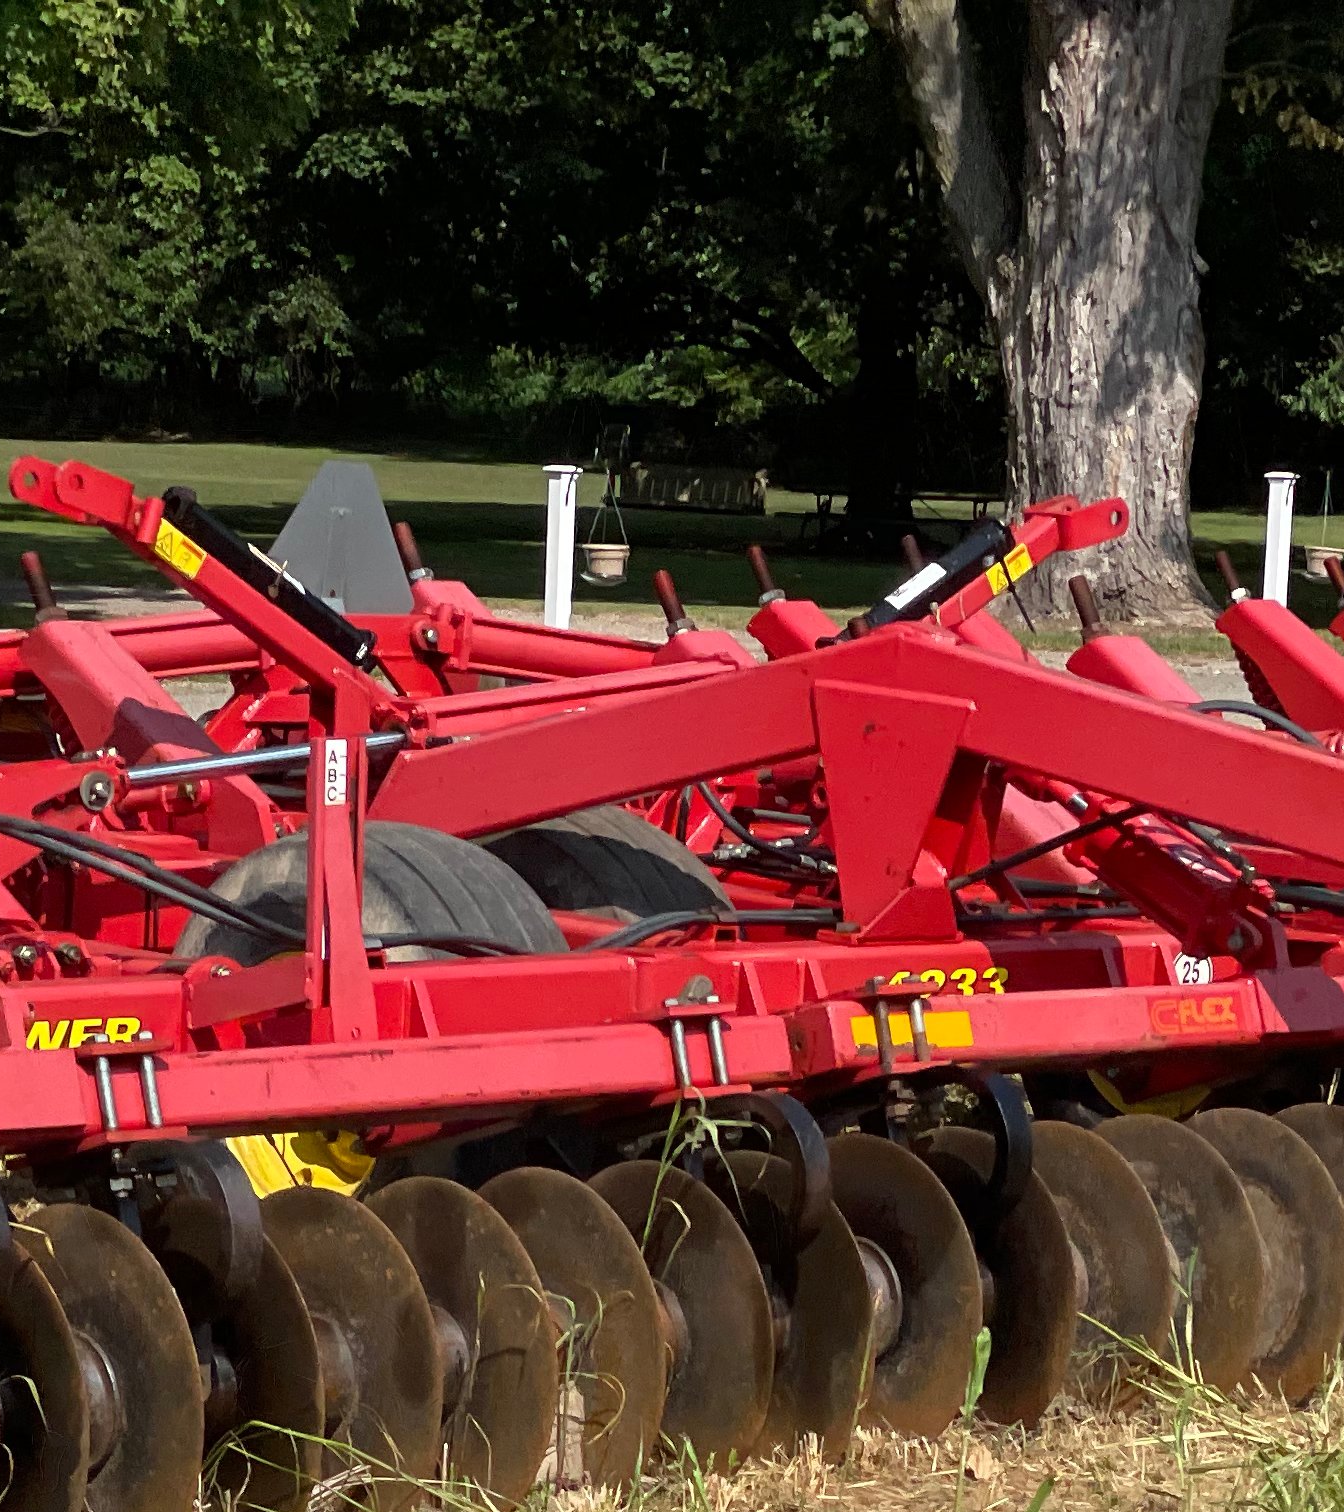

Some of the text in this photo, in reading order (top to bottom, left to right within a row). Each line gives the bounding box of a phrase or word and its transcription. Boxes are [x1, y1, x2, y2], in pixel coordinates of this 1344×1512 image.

[328, 749, 338, 765] A
[327, 768, 337, 783] B
[327, 786, 338, 802] C
[1182, 961, 1200, 984] 25
